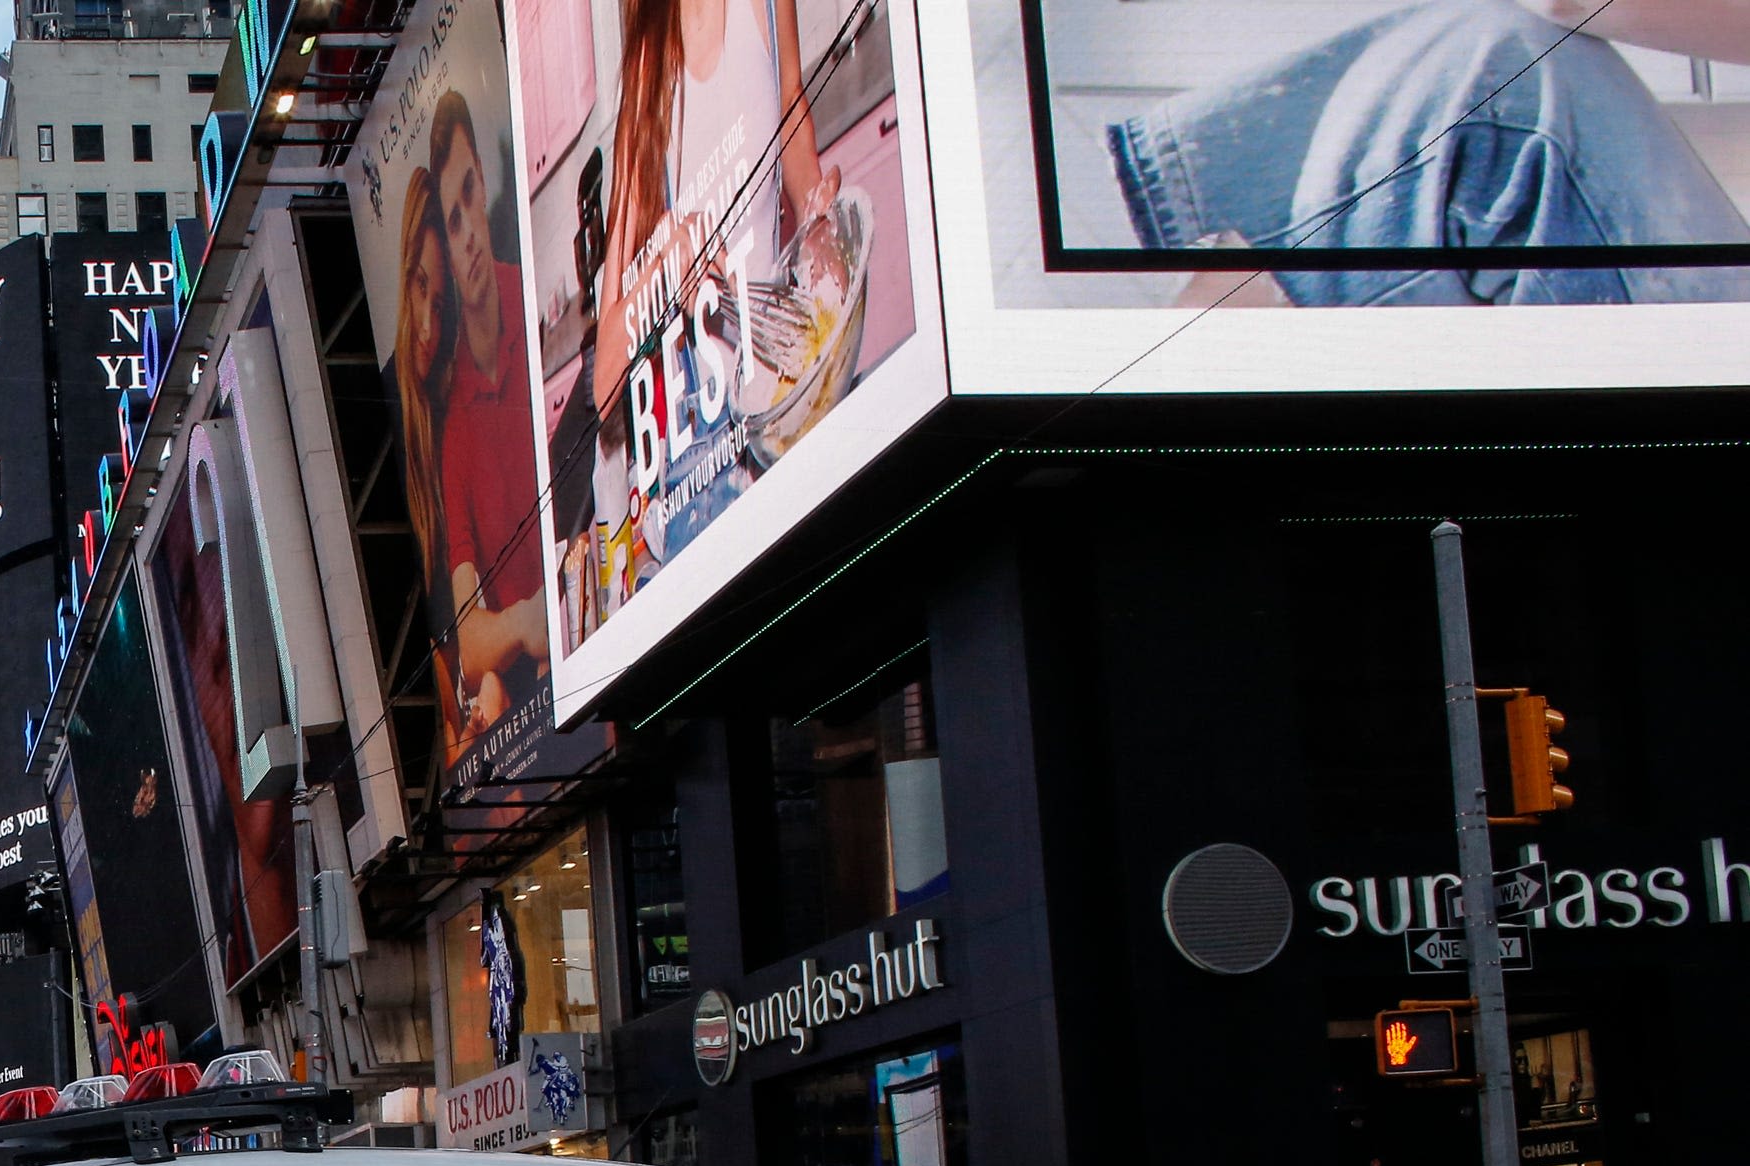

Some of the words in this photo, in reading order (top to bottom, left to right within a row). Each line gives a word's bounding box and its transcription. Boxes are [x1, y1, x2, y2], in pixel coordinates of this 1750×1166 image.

[379, 114, 401, 164] U.S.
[399, 46, 430, 126] POLO
[432, 0, 460, 60] ASS
[402, 107, 426, 160] SINCE
[621, 246, 646, 297] DON'T
[646, 212, 671, 266] SHOW
[671, 196, 696, 231] YOUR
[696, 145, 721, 198] BEST
[721, 114, 746, 164] SIDE
[83, 262, 174, 295] HAP
[624, 241, 681, 360] SHOW
[688, 158, 751, 274] YOUR
[629, 226, 755, 498] BEST
[457, 753, 482, 787] LIVE
[482, 686, 551, 763] AUTHENTIC
[16, 805, 49, 836] you
[1310, 842, 1690, 938] sunass
[1500, 879, 1532, 903] WAY
[1426, 942, 1462, 959] ONE
[736, 957, 866, 1056] sunglass
[868, 918, 944, 1007] hut
[4, 1065, 24, 1083] Event
[447, 1093, 473, 1134] U.S.
[473, 1076, 516, 1126] POLO
[473, 1129, 506, 1151] SINCE
[509, 1122, 538, 1144] 18
[1521, 1139, 1580, 1158] CHANEL
